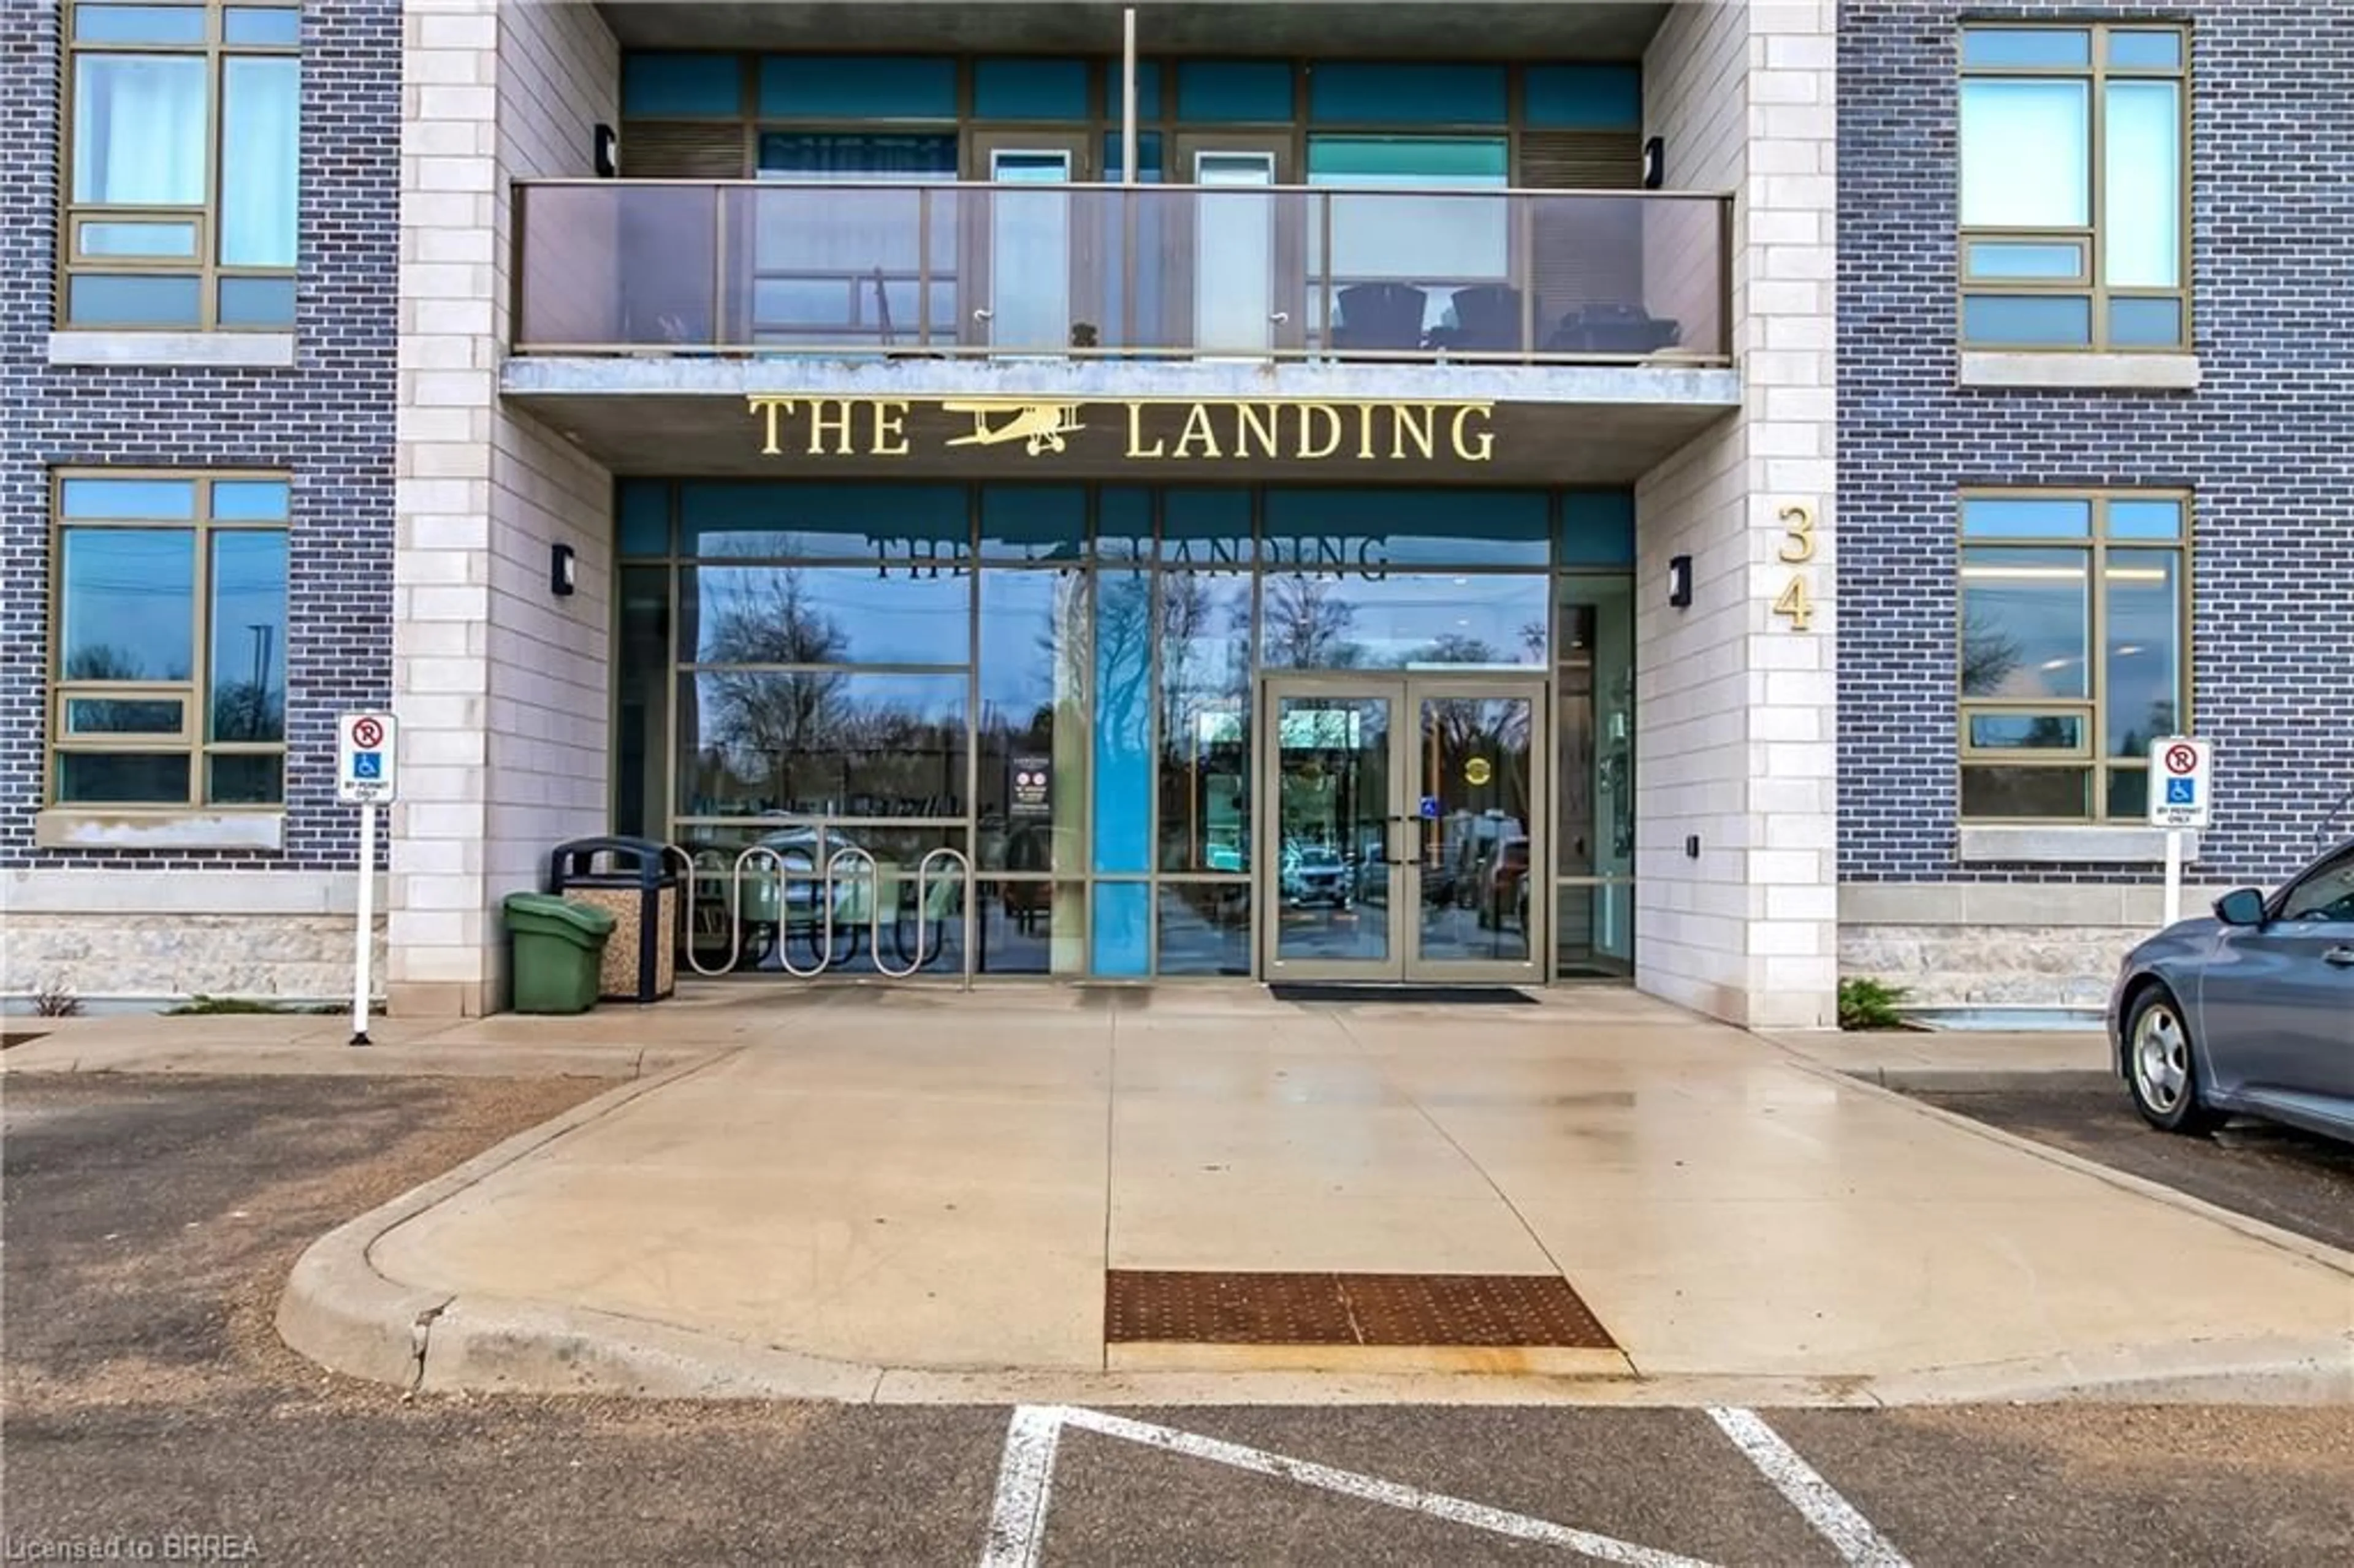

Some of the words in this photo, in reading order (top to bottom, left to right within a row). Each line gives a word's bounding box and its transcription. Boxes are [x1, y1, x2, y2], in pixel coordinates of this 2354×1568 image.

[749, 401, 910, 454] THE
[1126, 402, 1496, 461] LANDING
[1773, 508, 1813, 631] 34
